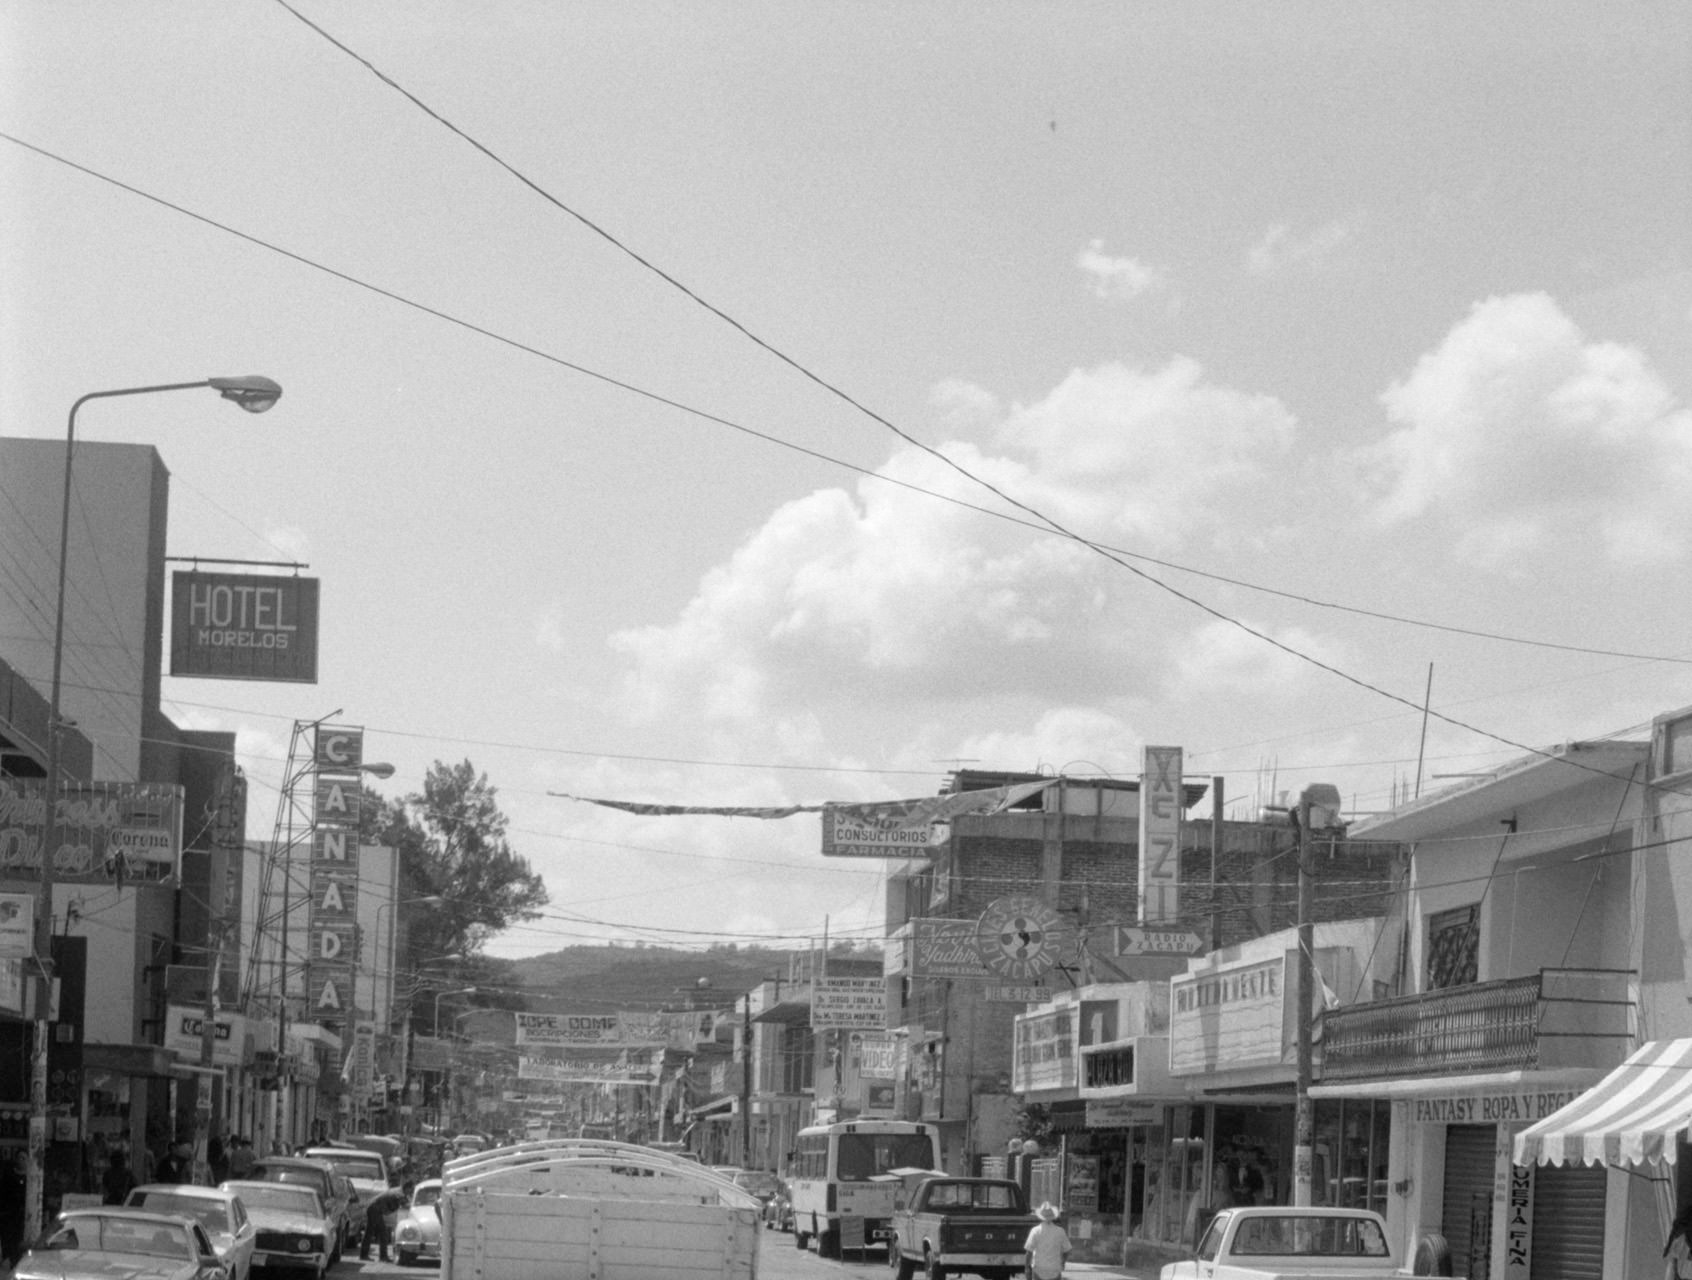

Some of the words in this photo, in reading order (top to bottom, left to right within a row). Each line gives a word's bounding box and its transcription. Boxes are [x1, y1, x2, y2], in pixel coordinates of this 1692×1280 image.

[190, 583, 297, 631] HOTEL
[198, 629, 289, 649] MORELOS
[111, 830, 169, 848] Corona
[836, 828, 928, 843] CONSULTORIOS
[836, 845, 927, 857] FARMACIA
[318, 735, 349, 1009] CANADA
[1137, 942, 1194, 951] ZACAPU
[1144, 934, 1187, 942] RADIO
[990, 951, 1053, 978] ZACAPU
[184, 1020, 228, 1038] Cona
[863, 1051, 895, 1069] VIDEO
[1416, 1098, 1476, 1121] FANTASY
[1483, 1095, 1520, 1120] ROPA
[1523, 1095, 1534, 1119] Y
[1509, 1230, 1528, 1267] FINA
